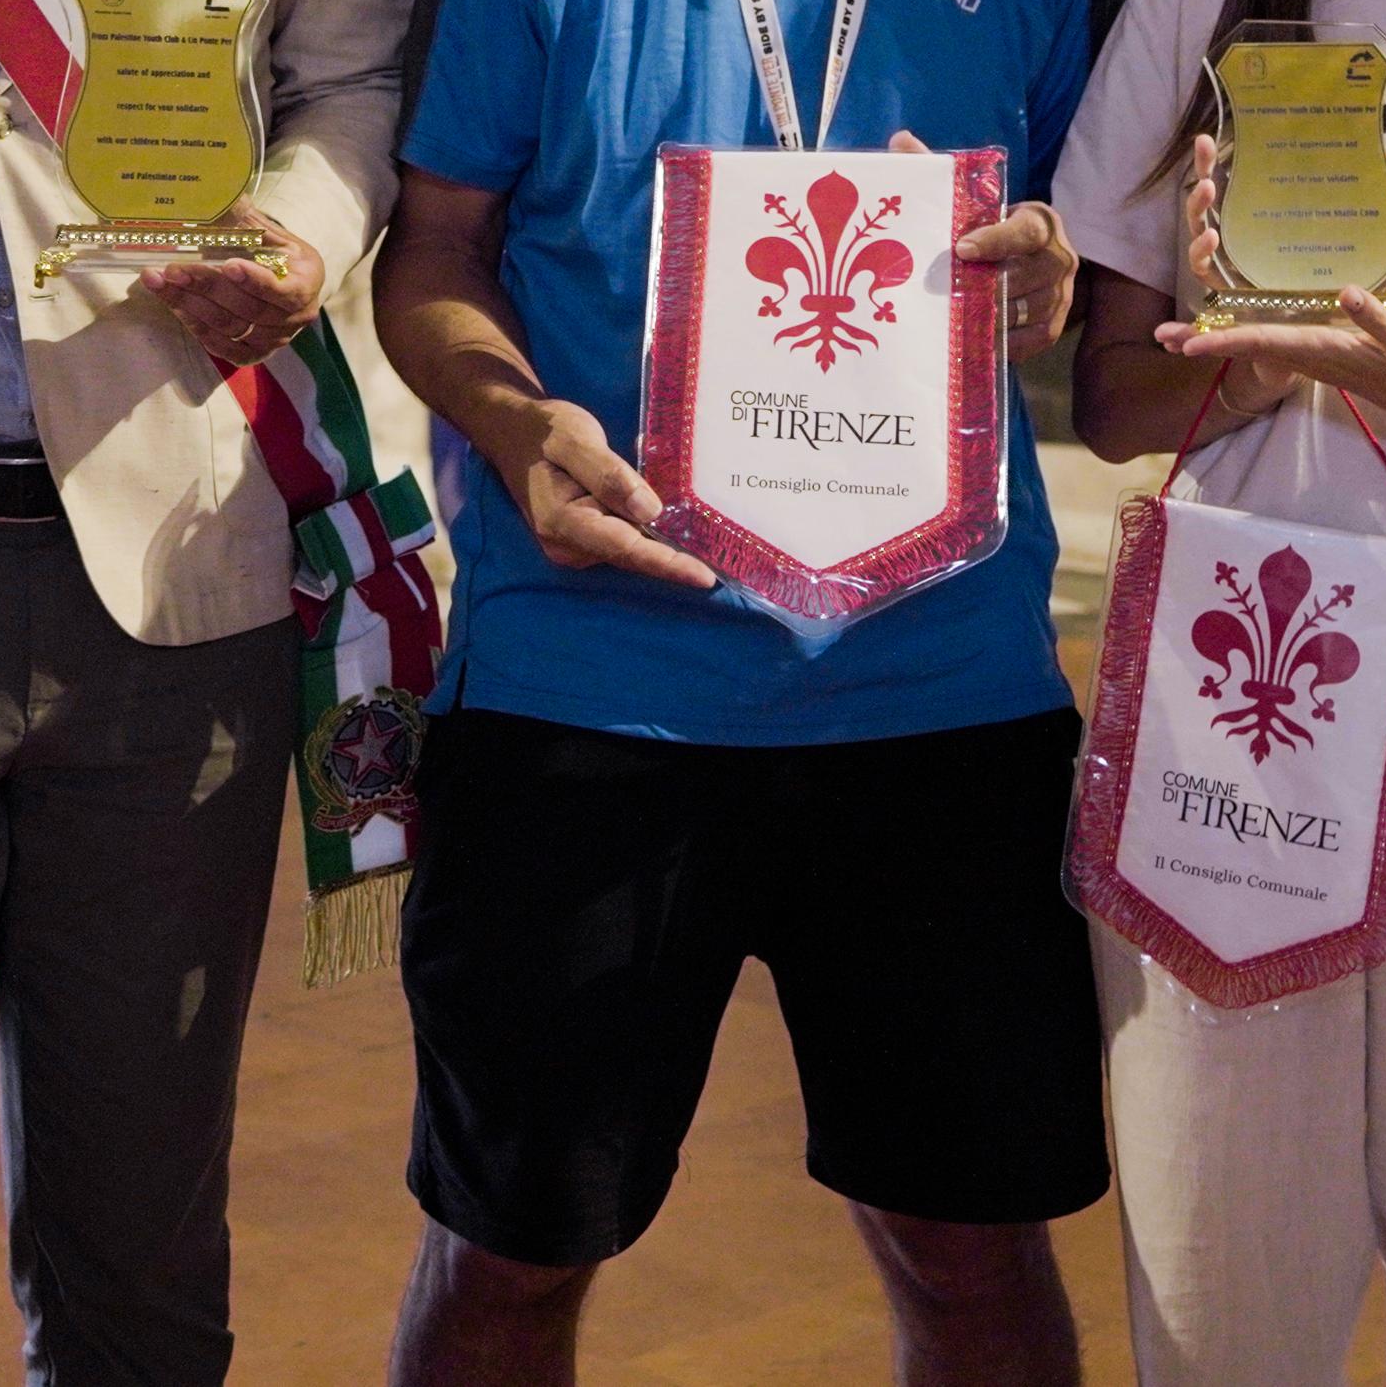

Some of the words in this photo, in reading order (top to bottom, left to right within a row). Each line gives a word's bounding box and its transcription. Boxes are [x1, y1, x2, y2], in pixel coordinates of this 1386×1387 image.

[753, 7, 766, 23] BY
[842, 8, 853, 26] BY
[110, 33, 141, 43] Palestine
[143, 34, 162, 44] Youth
[164, 35, 179, 44] Club
[199, 37, 219, 46] Ponte
[220, 38, 232, 46] Per
[758, 26, 773, 55] SIDE
[837, 29, 848, 56] SIDE
[117, 68, 138, 77] salute
[141, 68, 149, 77] of
[151, 69, 195, 79] appreciation
[197, 71, 211, 79] and
[761, 56, 776, 77] PER
[766, 78, 785, 112] PONTE
[117, 103, 143, 113] respect
[145, 103, 156, 112] for
[158, 104, 174, 113] your
[176, 104, 209, 114] solidarity
[96, 136, 113, 145] with
[130, 137, 159, 147] children
[162, 138, 179, 147] from
[207, 140, 227, 149] Camp
[121, 171, 134, 180] and
[136, 172, 177, 182] Palestinian
[154, 197, 175, 205] 2025
[1313, 268, 1333, 276] 2025
[731, 390, 809, 409] COMUNE
[732, 407, 748, 421] DI
[750, 407, 916, 451] FIRENZE
[731, 474, 741, 487] Il
[746, 474, 821, 493] Consiglio
[827, 480, 910, 497] Comunale
[1163, 770, 1240, 799] COMUNE
[1163, 787, 1179, 804] DI
[1178, 790, 1342, 853] FIRENZE
[1154, 855, 1165, 870] Il
[1169, 859, 1242, 885] Consiglio
[1247, 874, 1329, 902] Comunale
